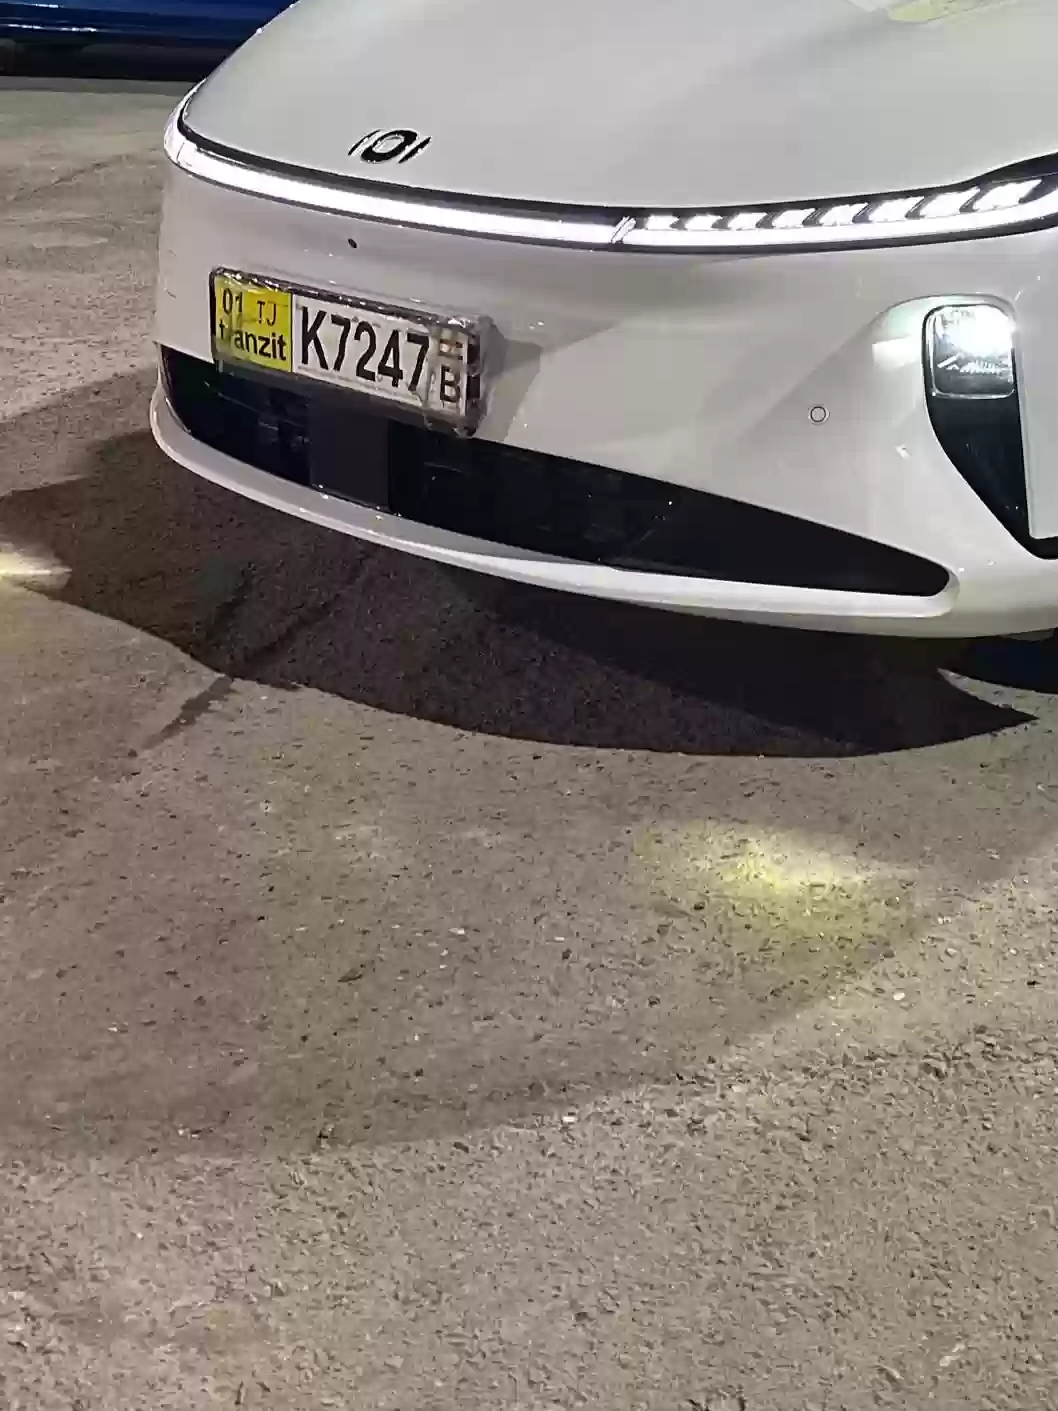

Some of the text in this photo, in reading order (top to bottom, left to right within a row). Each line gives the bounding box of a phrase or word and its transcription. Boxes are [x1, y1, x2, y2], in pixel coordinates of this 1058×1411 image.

[223, 288, 277, 326] 01 TJ
[219, 318, 287, 361] tanzit
[300, 306, 430, 392] K7247
